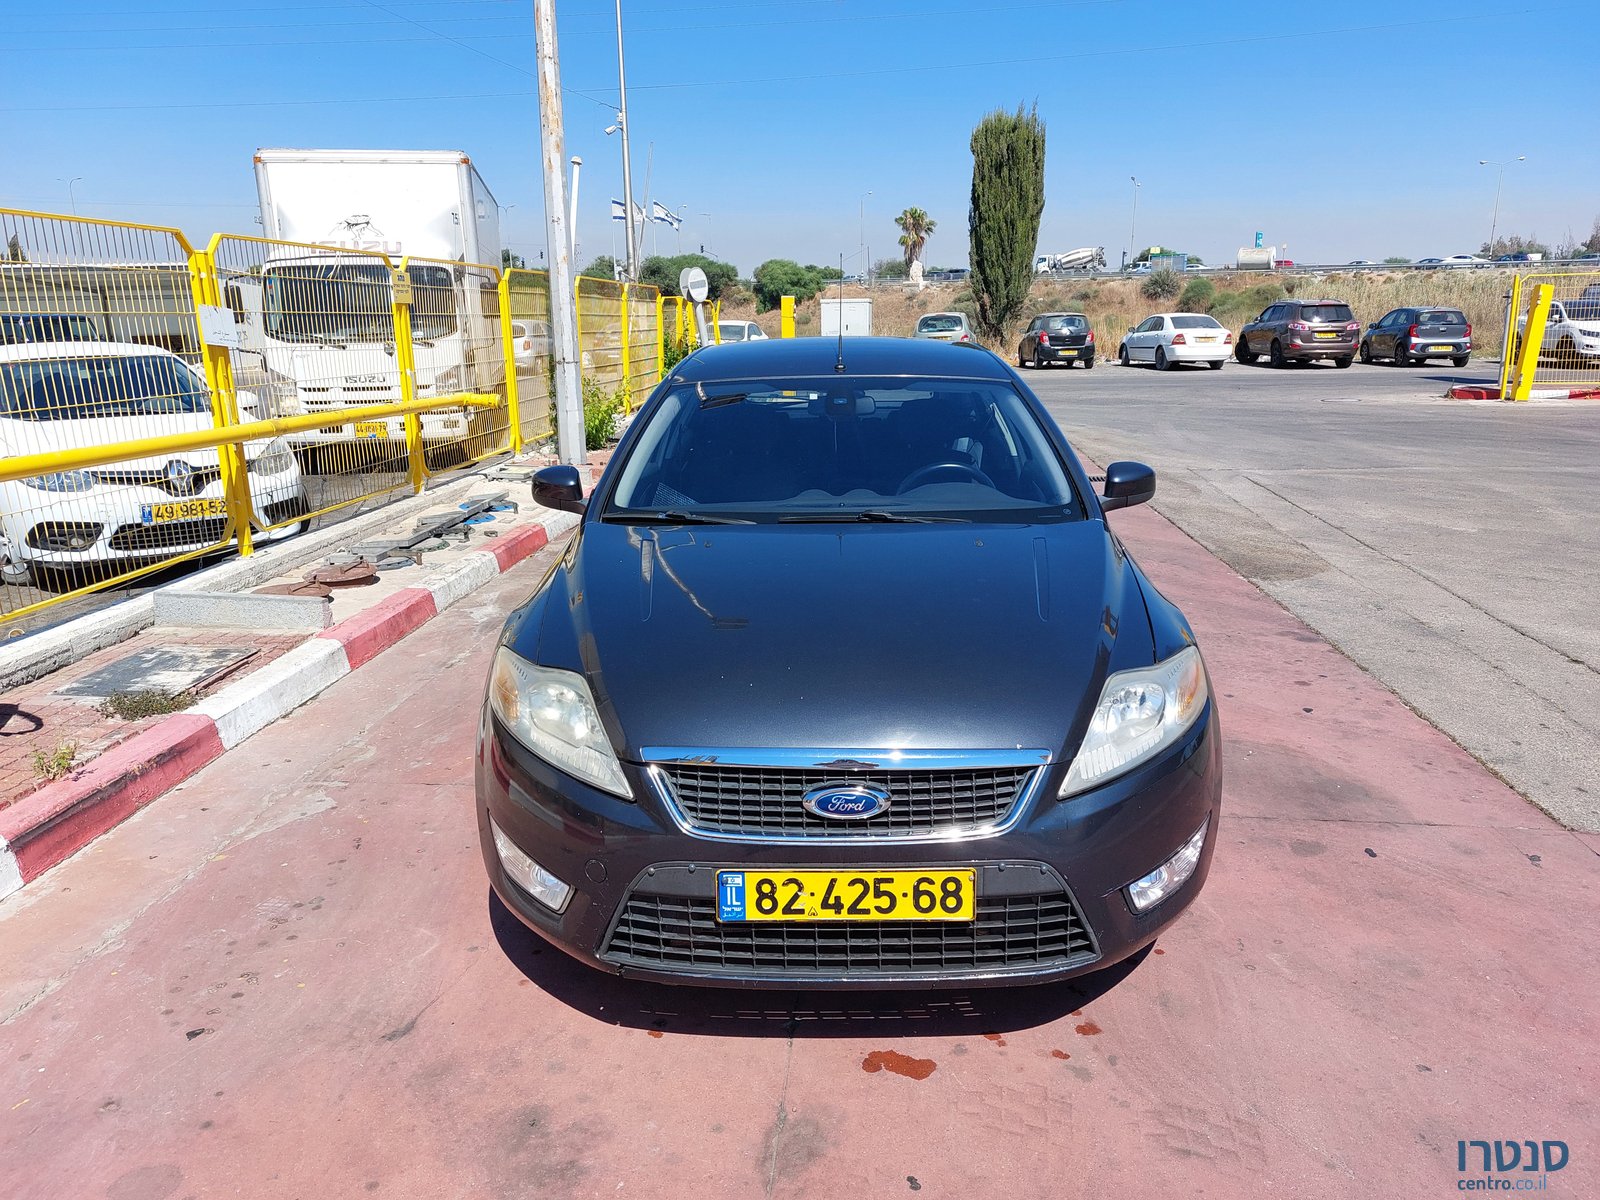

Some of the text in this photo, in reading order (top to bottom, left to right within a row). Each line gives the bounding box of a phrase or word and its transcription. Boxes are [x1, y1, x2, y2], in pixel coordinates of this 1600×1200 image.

[311, 241, 402, 254] ISUZU
[828, 795, 866, 811] Ford
[726, 886, 741, 905] IL
